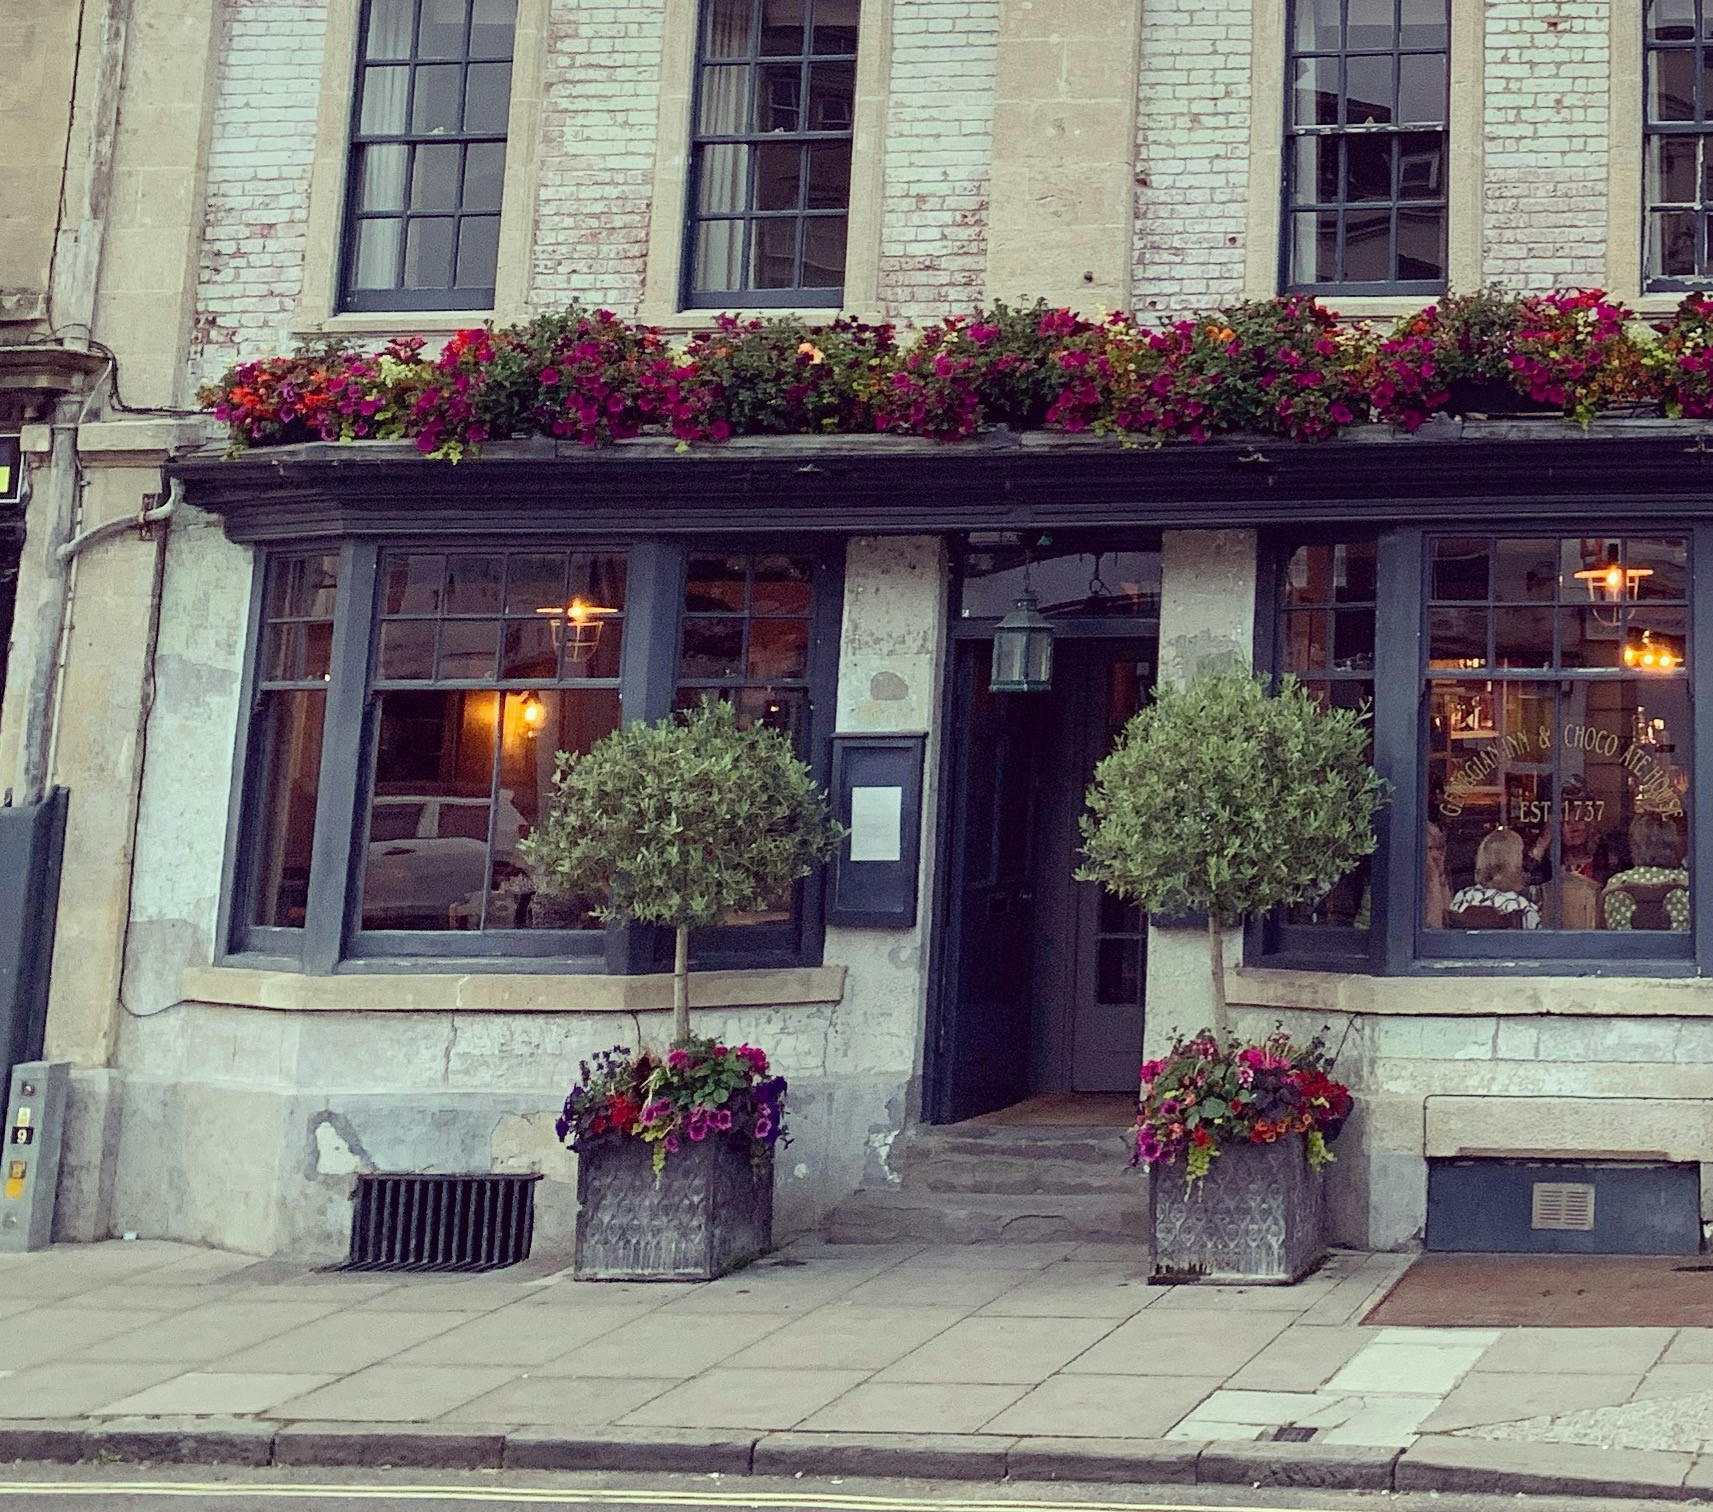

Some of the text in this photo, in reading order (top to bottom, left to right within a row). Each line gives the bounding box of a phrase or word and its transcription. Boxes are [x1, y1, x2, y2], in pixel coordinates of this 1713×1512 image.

[1501, 729, 1530, 759] INN
[1539, 725, 1551, 749] &
[1520, 800, 1605, 823] EST 1737
